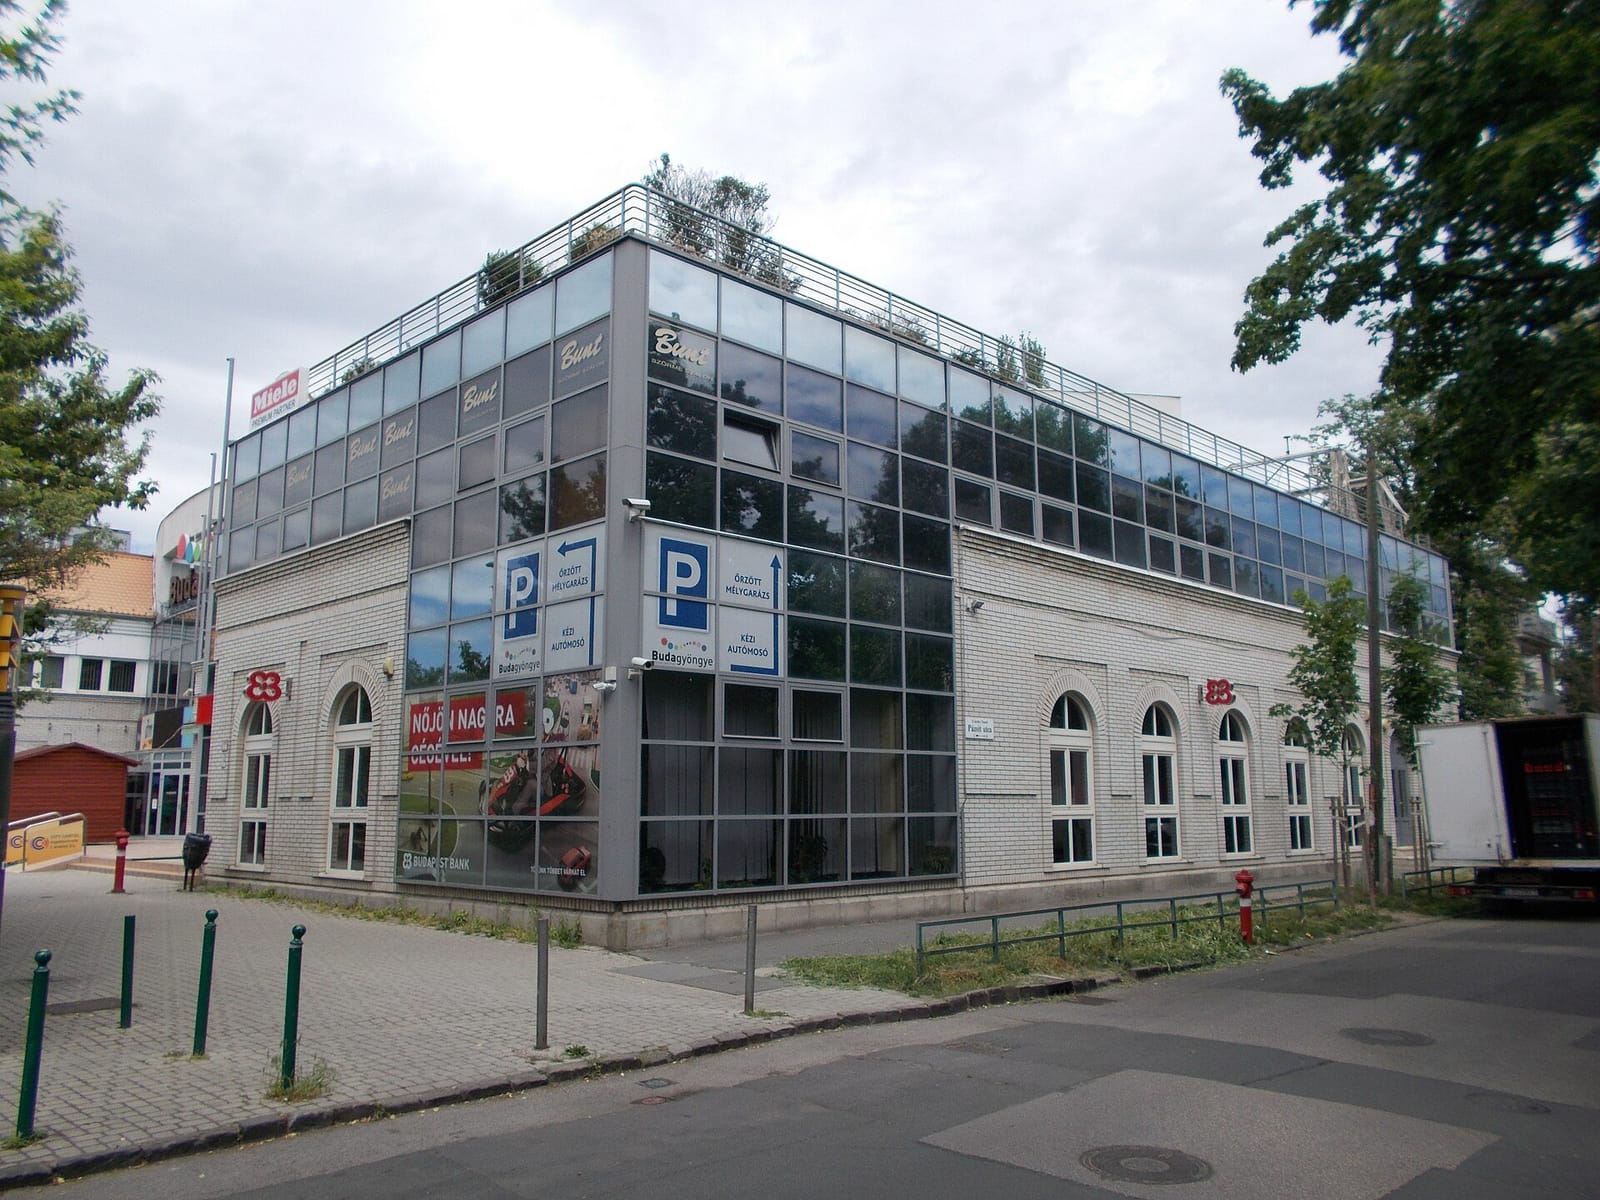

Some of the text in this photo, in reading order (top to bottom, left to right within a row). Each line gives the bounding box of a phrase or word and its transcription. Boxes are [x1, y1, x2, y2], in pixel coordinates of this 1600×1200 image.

[560, 333, 603, 370] Bunt
[655, 328, 710, 366] Bunt
[253, 378, 297, 414] Miele
[463, 381, 498, 412] Bunt
[384, 419, 414, 446] Bunt
[350, 435, 377, 461] Bunt
[383, 474, 411, 500] Bunt
[552, 577, 589, 592] MÉLYGARÁZS
[726, 585, 770, 600] MÉLYGARÁZS
[562, 626, 575, 637] KÉZI
[740, 633, 756, 643] KÉZI
[551, 636, 585, 651] AUTÓMOSÓ
[728, 645, 769, 657] AUTÓMOSÓ
[498, 660, 541, 674] Budagyöngye
[652, 650, 713, 668] Budagyöngye
[458, 704, 515, 730] NAGRA
[413, 855, 470, 870] BUDAPST BANK
